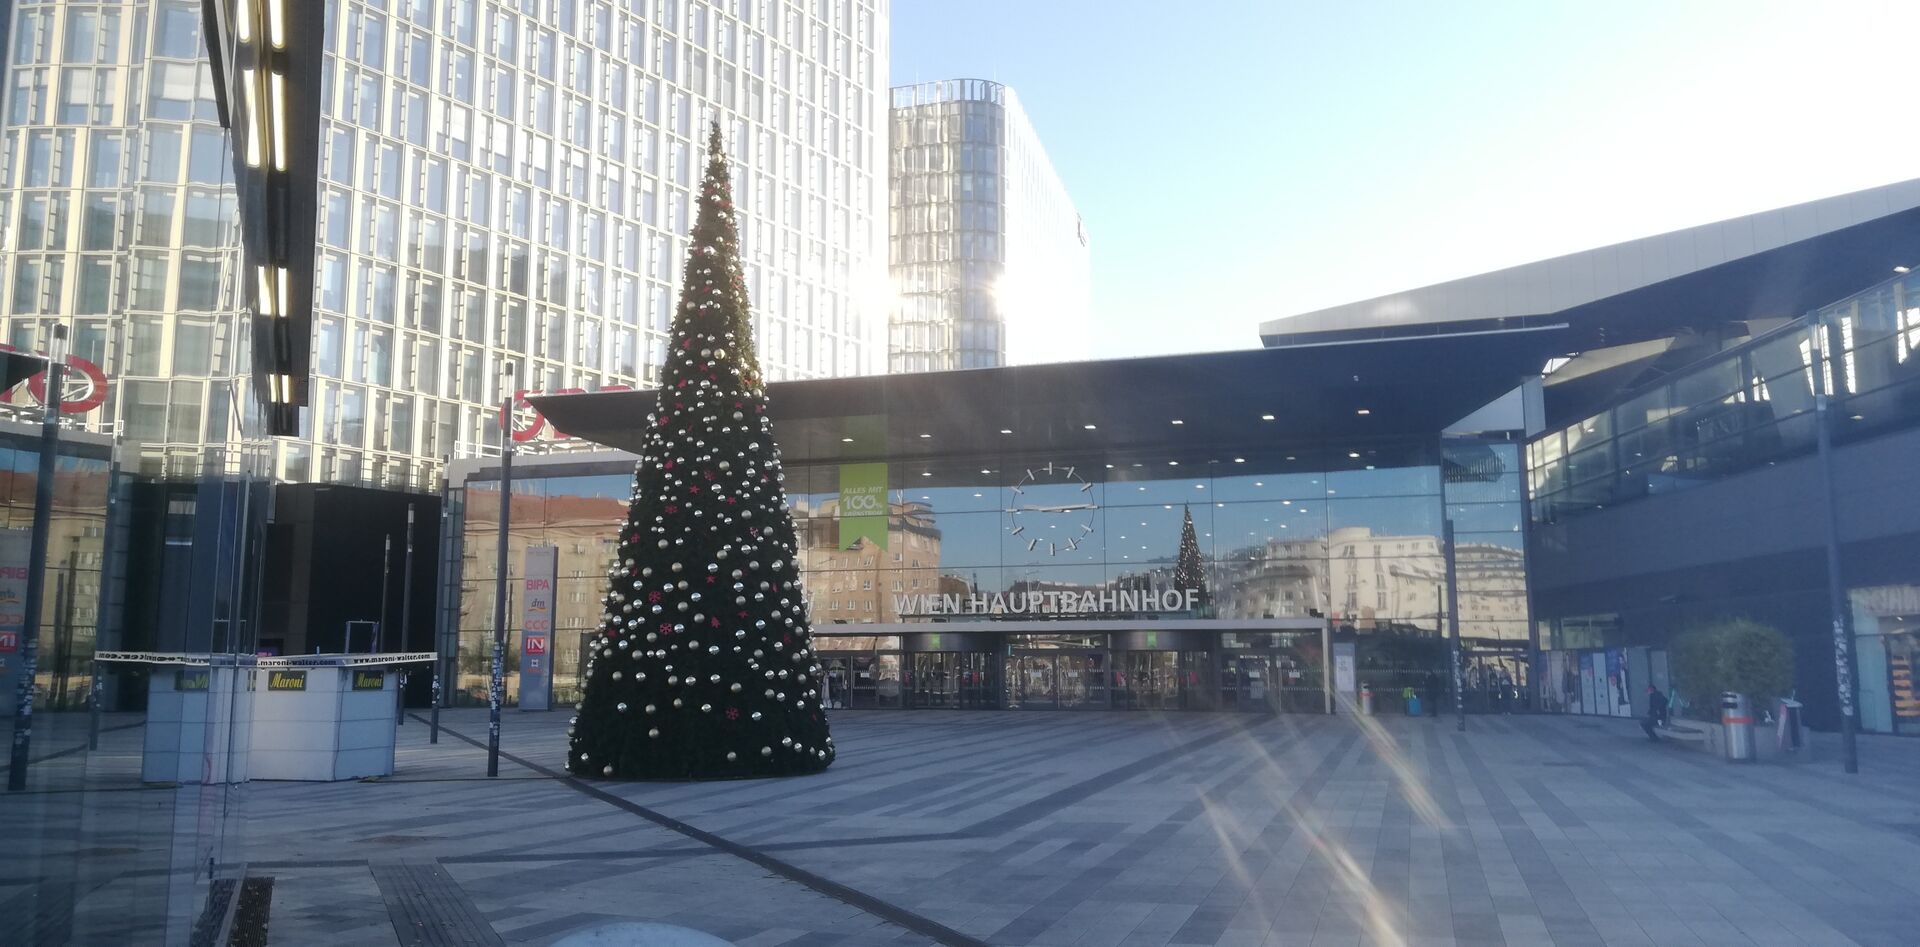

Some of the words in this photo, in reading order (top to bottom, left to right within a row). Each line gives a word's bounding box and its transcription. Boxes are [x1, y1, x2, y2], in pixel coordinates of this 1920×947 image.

[868, 486, 883, 494] MIT
[526, 579, 549, 591] BIPA
[531, 598, 545, 608] dm
[894, 592, 959, 615] WIEN
[972, 588, 1199, 615] HAUPTBAHNHOF
[525, 620, 548, 630] CCC
[527, 638, 545, 650] IN
[270, 671, 305, 689] Maroni
[354, 672, 384, 689] Maroni
